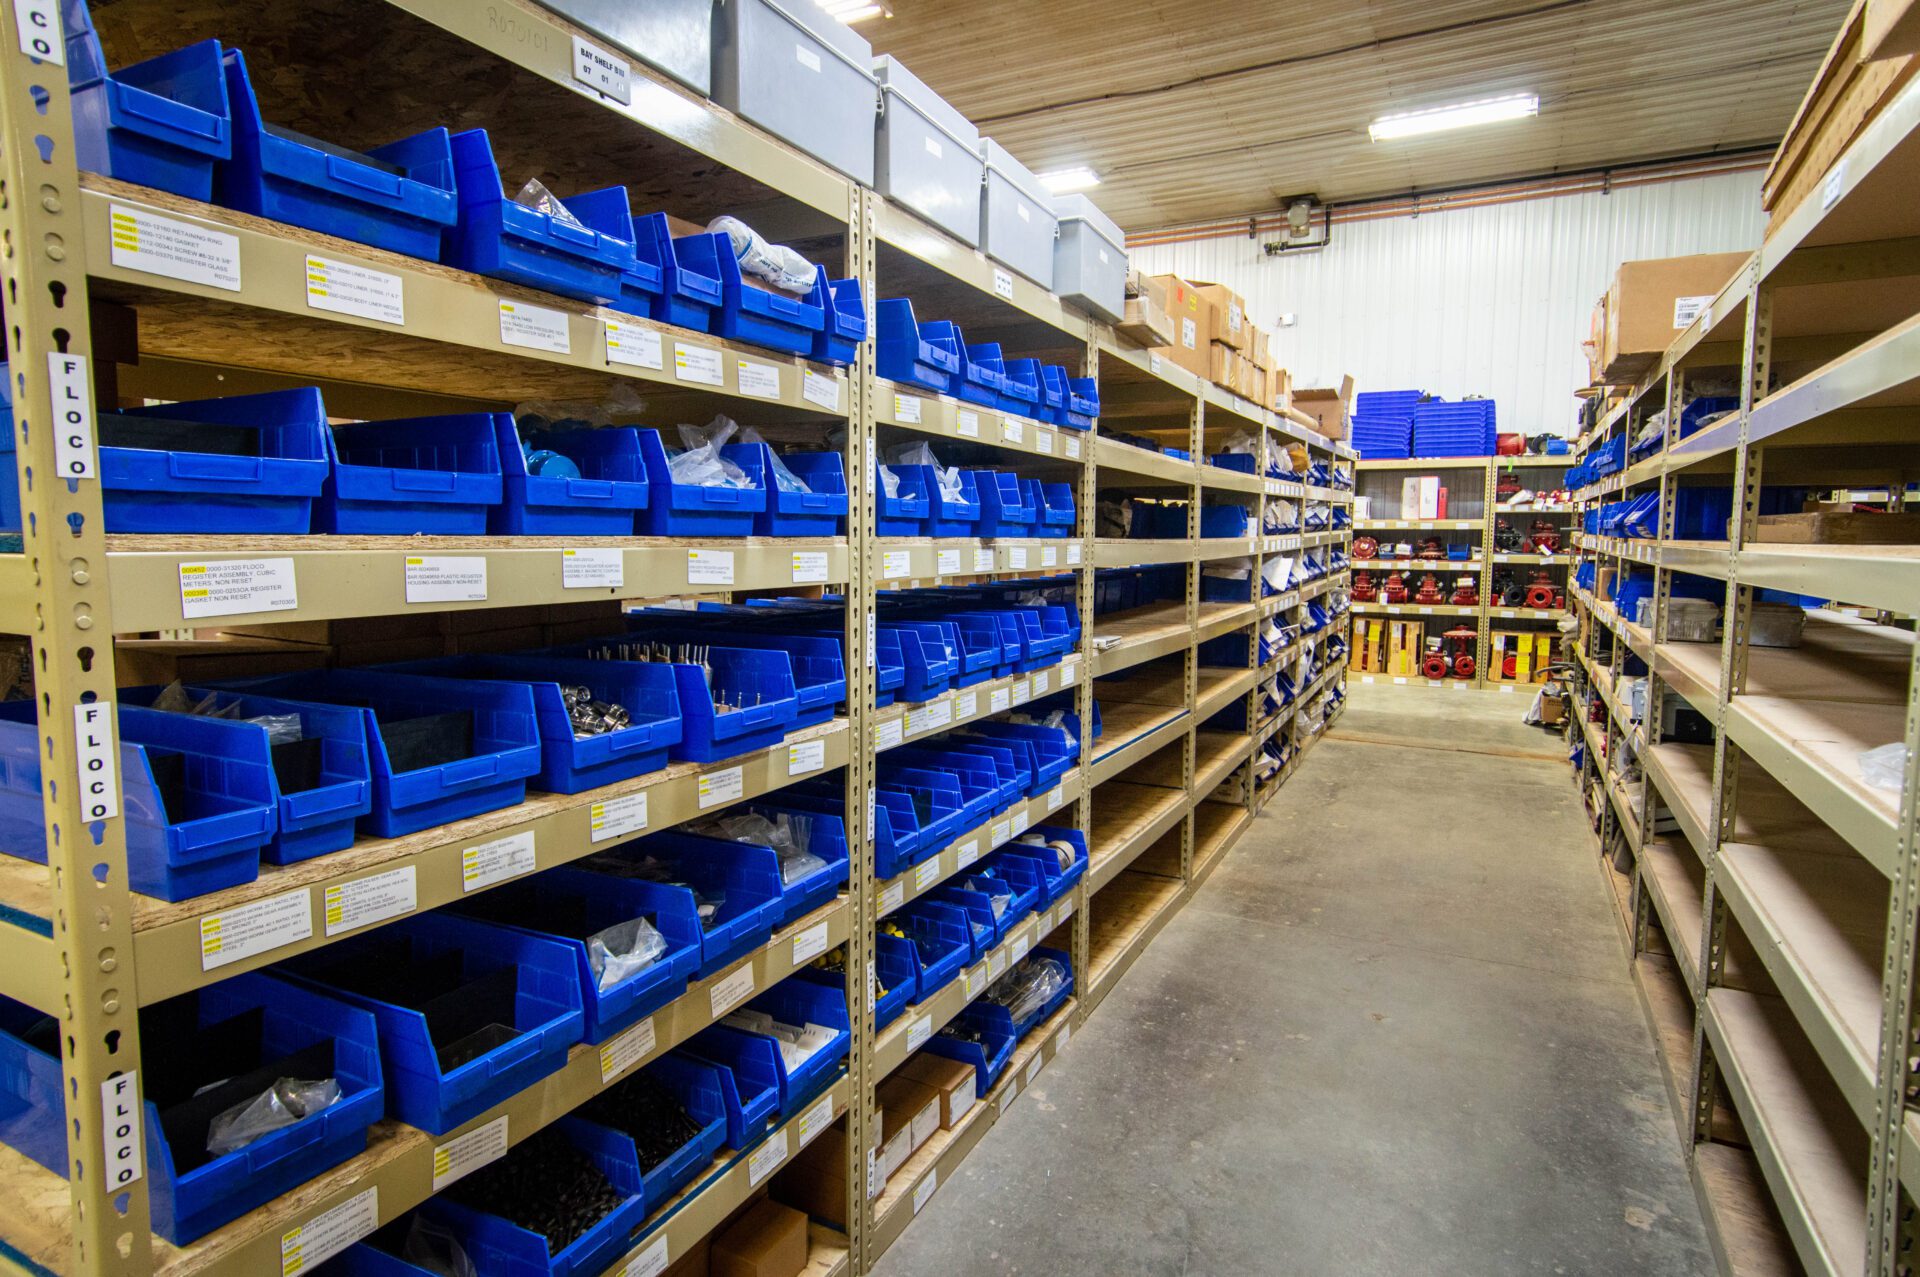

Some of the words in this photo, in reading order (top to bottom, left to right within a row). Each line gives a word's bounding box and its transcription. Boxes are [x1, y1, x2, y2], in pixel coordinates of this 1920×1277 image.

[581, 48, 592, 60] BAY
[594, 56, 613, 70] SHELF
[583, 65, 592, 74] 07
[602, 74, 608, 84] 01
[172, 228, 205, 242] RETAINING
[207, 237, 222, 246] RING
[174, 238, 199, 249] GASKET
[174, 246, 196, 257] SCREW
[174, 255, 206, 267] REGISTER
[207, 263, 227, 272] GLASS
[64, 360, 86, 474] FLOCO
[86, 710, 106, 817] FLOCO
[116, 1080, 132, 1182] FLOCO
